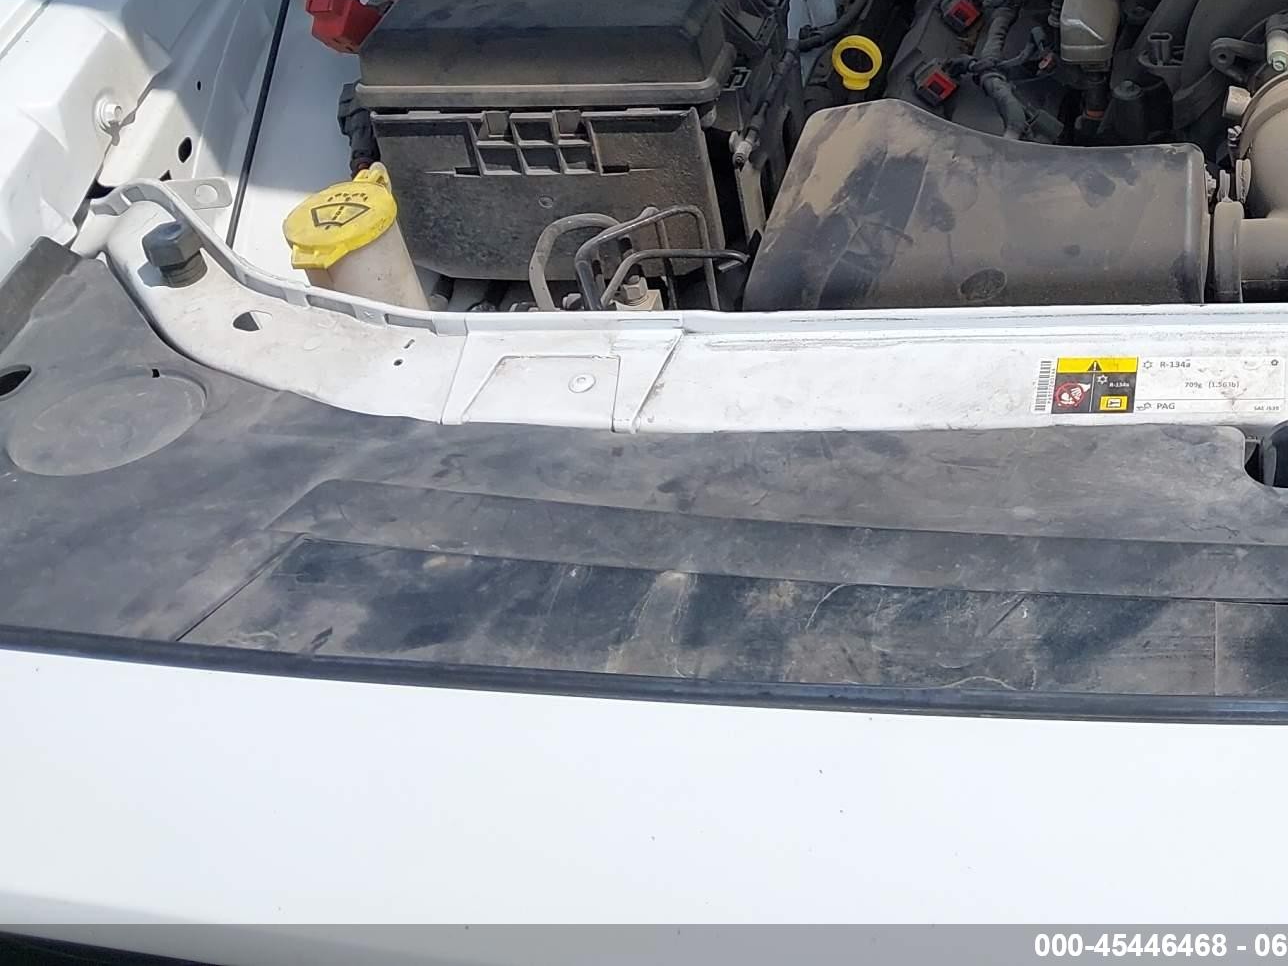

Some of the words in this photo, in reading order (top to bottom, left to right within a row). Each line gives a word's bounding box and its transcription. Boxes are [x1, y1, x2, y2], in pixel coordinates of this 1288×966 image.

[1159, 360, 1191, 368] R-134a
[1184, 381, 1203, 389] 709g
[1156, 402, 1176, 410] PAG
